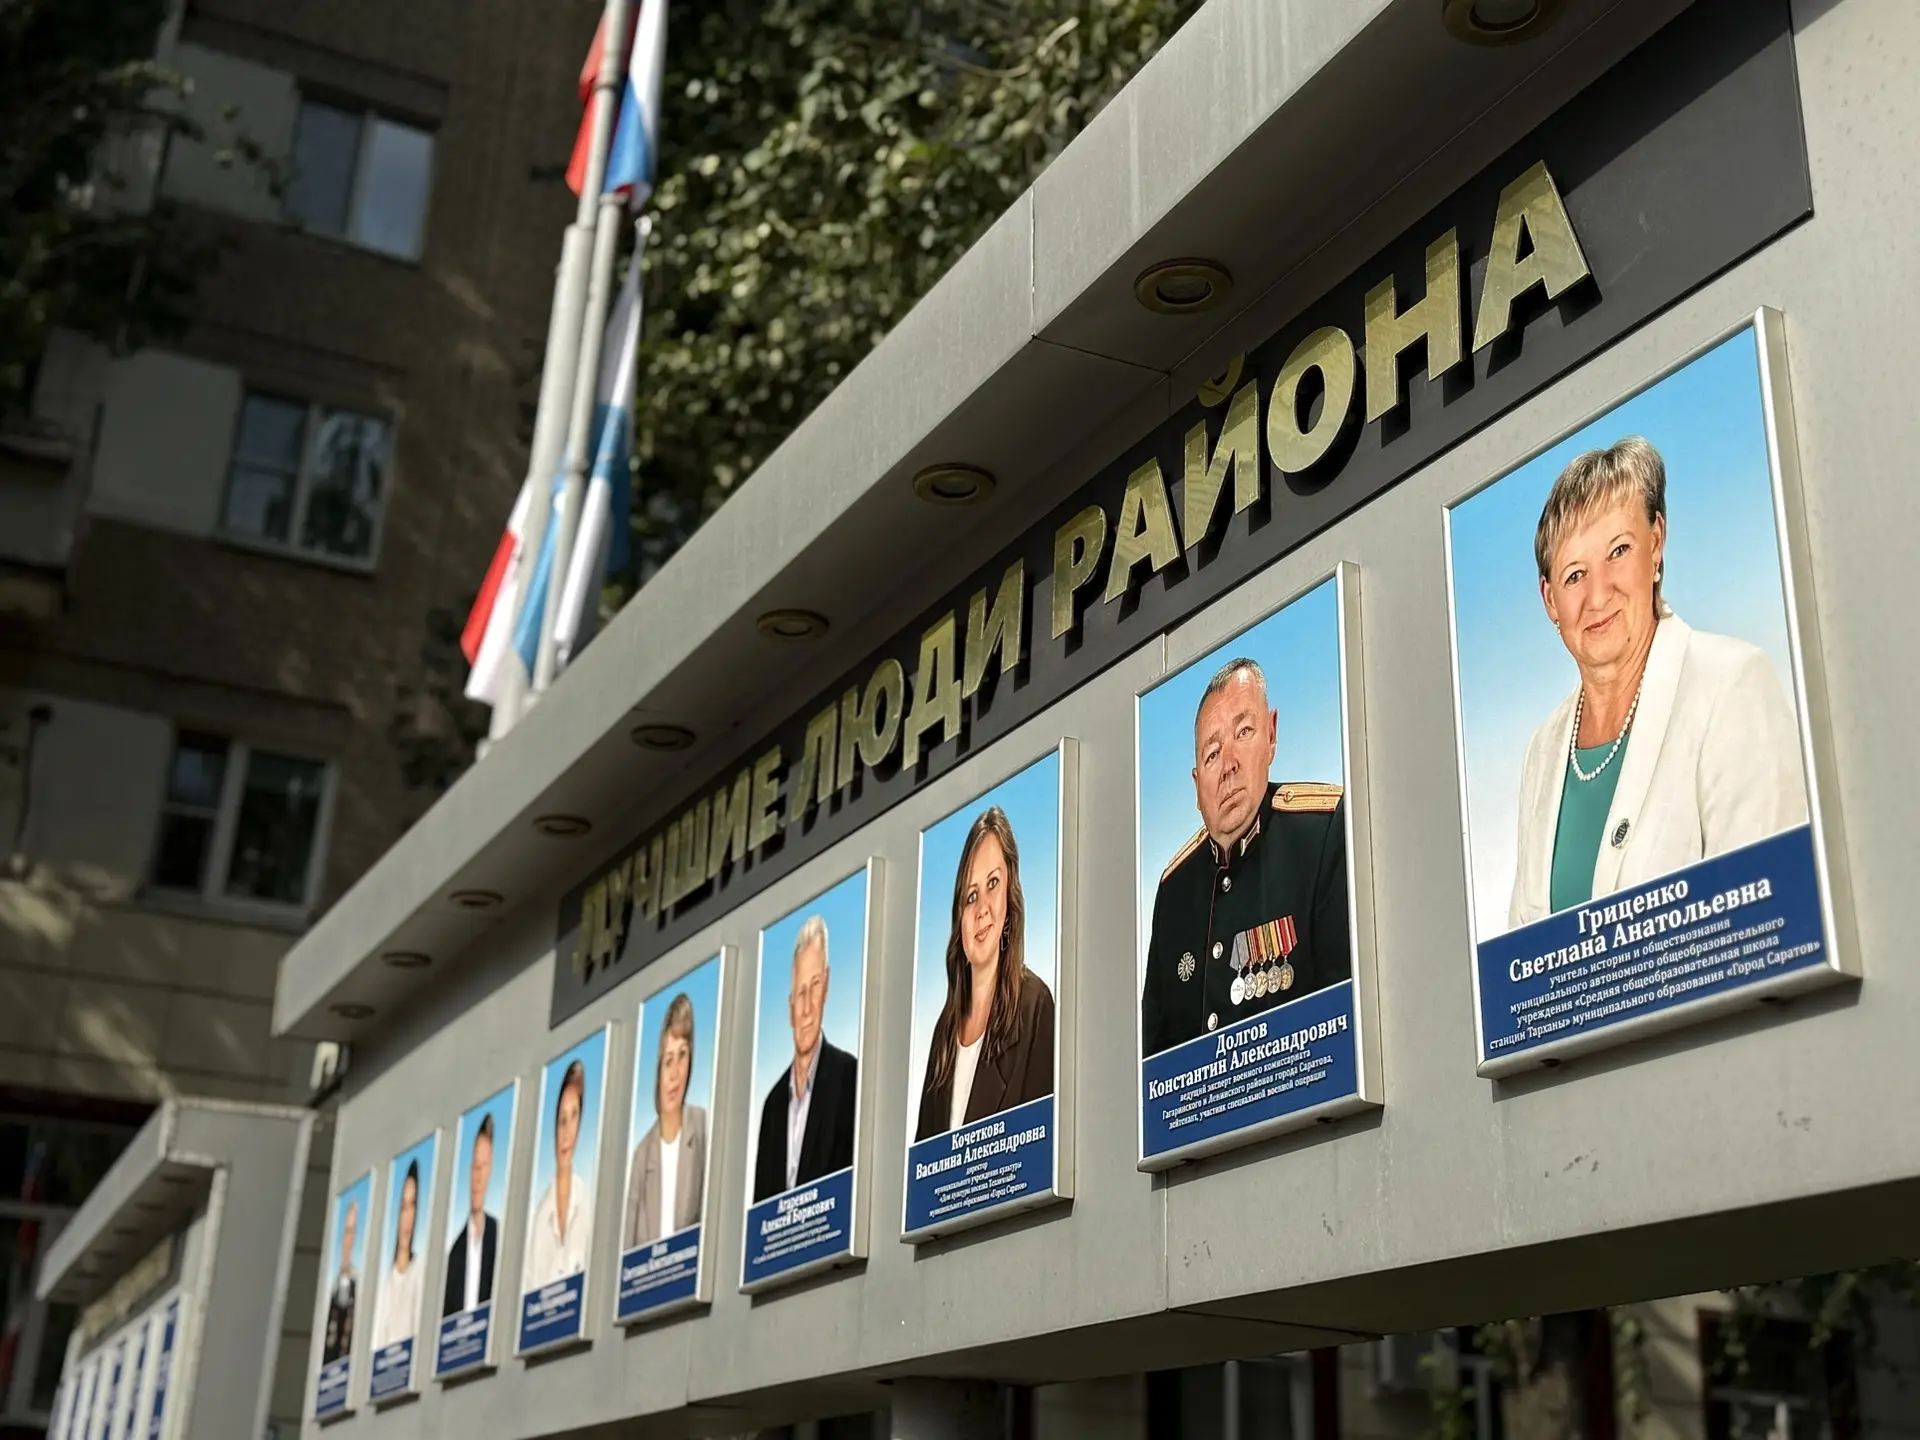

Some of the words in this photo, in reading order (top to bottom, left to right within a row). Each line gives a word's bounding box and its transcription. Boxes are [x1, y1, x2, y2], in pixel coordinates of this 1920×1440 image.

[571, 745, 784, 974] ЛУЧШИЕ
[790, 557, 1024, 822] ЛЮДИ
[1051, 159, 1590, 640] РАЙОНА
[1509, 934, 1607, 982] Светлана
[1613, 879, 1771, 948] Анатольевна
[1578, 880, 1688, 935] Гриценко
[1510, 981, 1588, 1014] муниципального
[1589, 959, 1655, 988] автономного
[1656, 918, 1784, 972] общеобразовательного
[1517, 1000, 1573, 1029] учреждения
[1574, 985, 1621, 1007] «Средняя
[1622, 948, 1740, 992] общеобразовательная
[1742, 935, 1779, 955] школа
[1549, 967, 1588, 989] учитель
[1590, 952, 1631, 973] истории
[1642, 919, 1730, 955] обществознания
[1489, 1031, 1526, 1050] станции
[1527, 1018, 1571, 1038] Тарханы»
[1572, 991, 1655, 1025] муниципального
[1656, 970, 1724, 998] образования
[1726, 957, 1765, 976] «Город
[1766, 942, 1820, 965] Саратов»
[1149, 1059, 1227, 1100] Константин
[1230, 1015, 1347, 1070] Александрович
[1215, 1022, 1268, 1058] Долгов
[1274, 1066, 1298, 1081] города
[1299, 1055, 1333, 1072] Саратова,
[1180, 1084, 1207, 1102] ведущий
[1207, 1077, 1232, 1092] эксперт
[1232, 1066, 1263, 1083] военного
[916, 1154, 962, 1180] Василина
[963, 1126, 1046, 1164] Александровна
[951, 1122, 1005, 1150] Кочеткова
